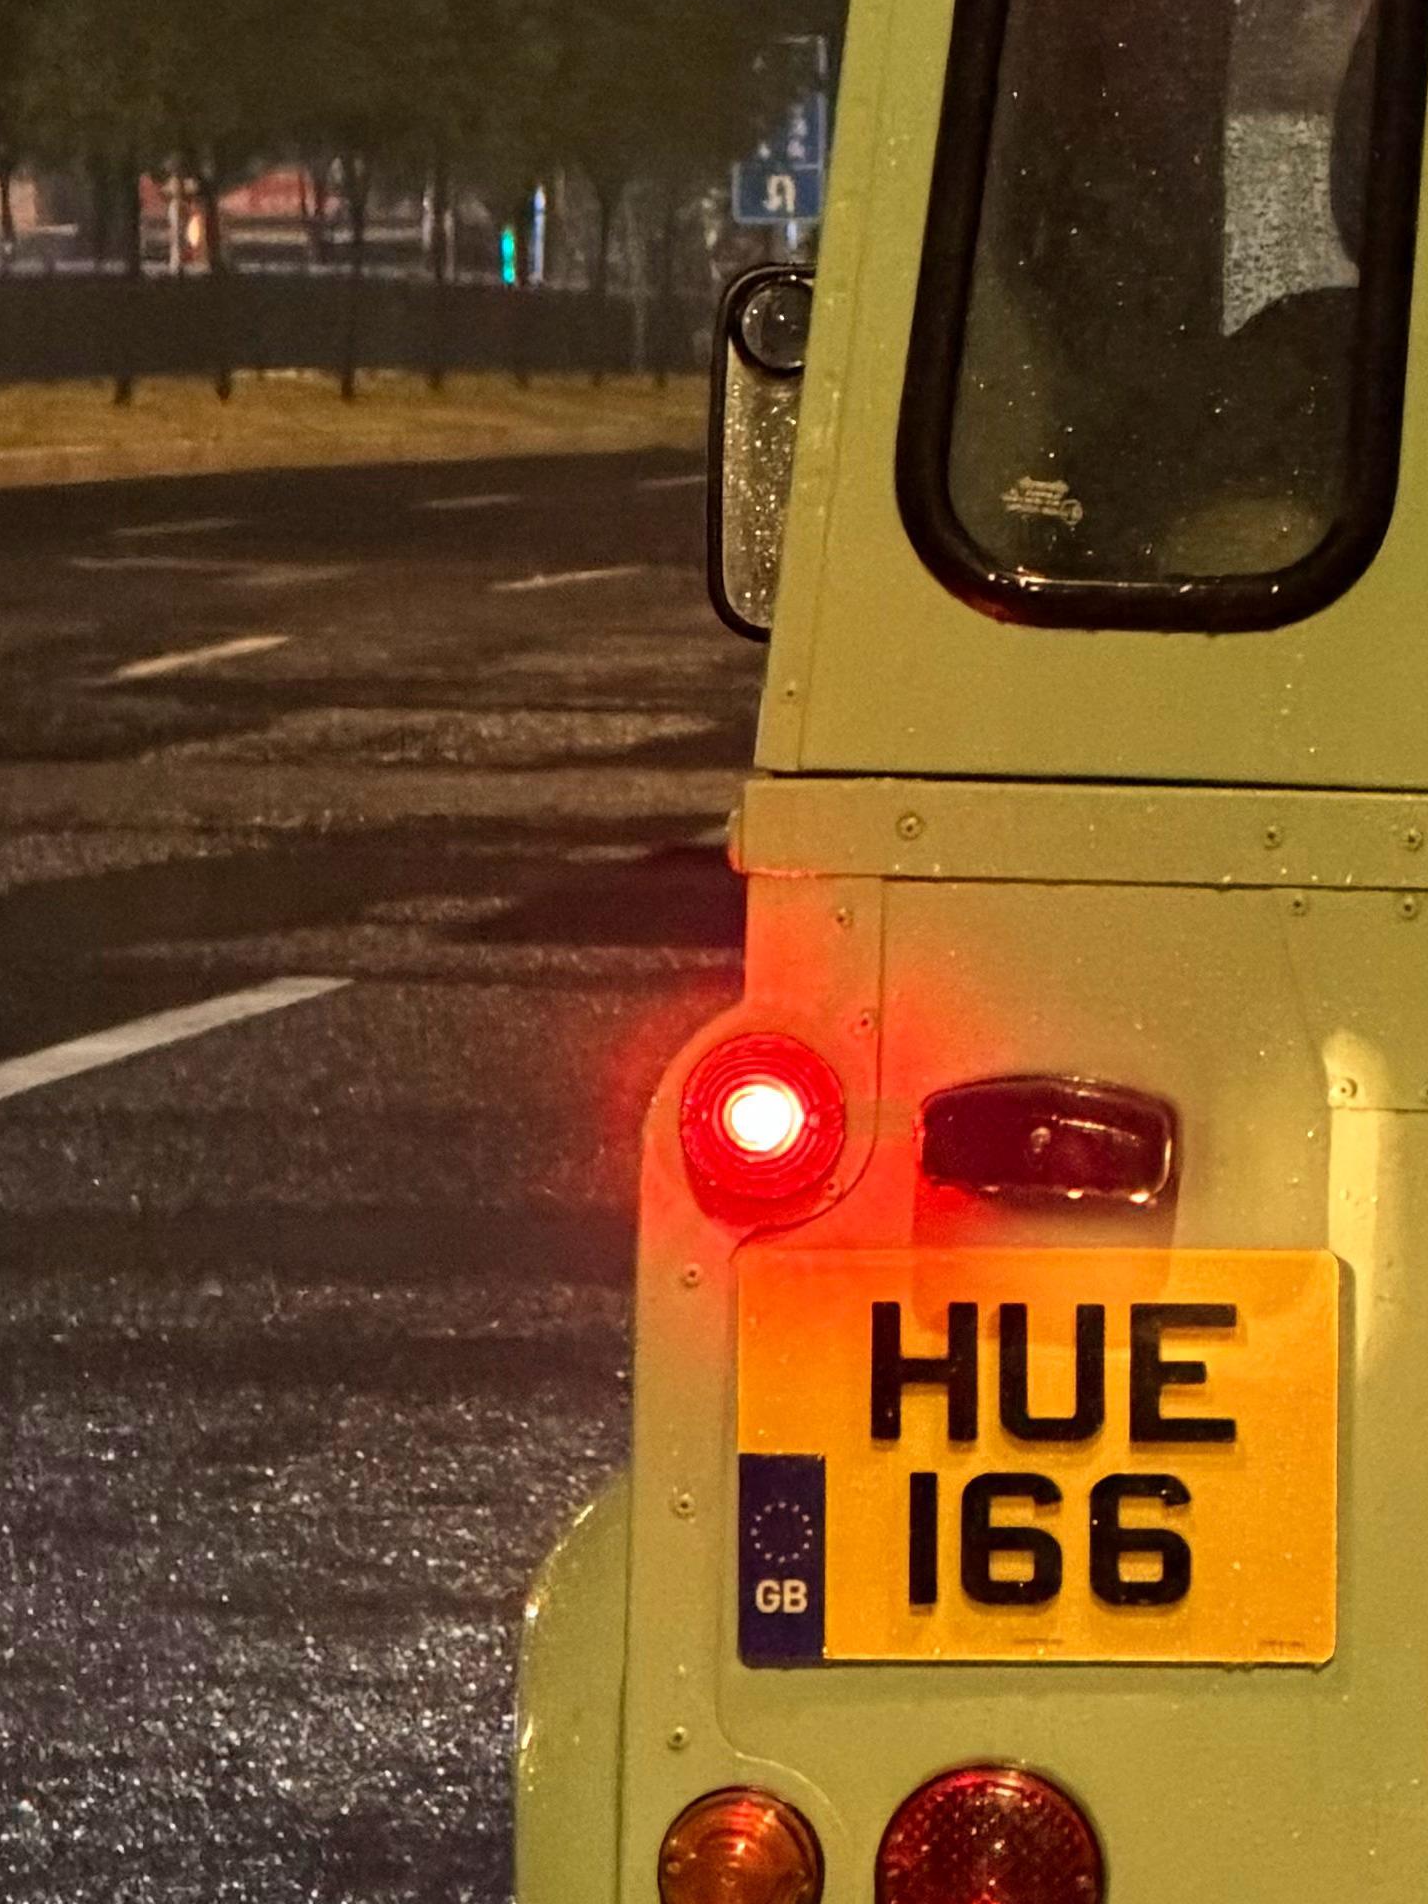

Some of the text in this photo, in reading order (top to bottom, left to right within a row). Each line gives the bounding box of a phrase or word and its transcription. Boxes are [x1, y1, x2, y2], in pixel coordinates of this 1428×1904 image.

[871, 1302, 1236, 1443] HUE
[755, 1580, 808, 1614] GB
[909, 1472, 1192, 1607] 166
